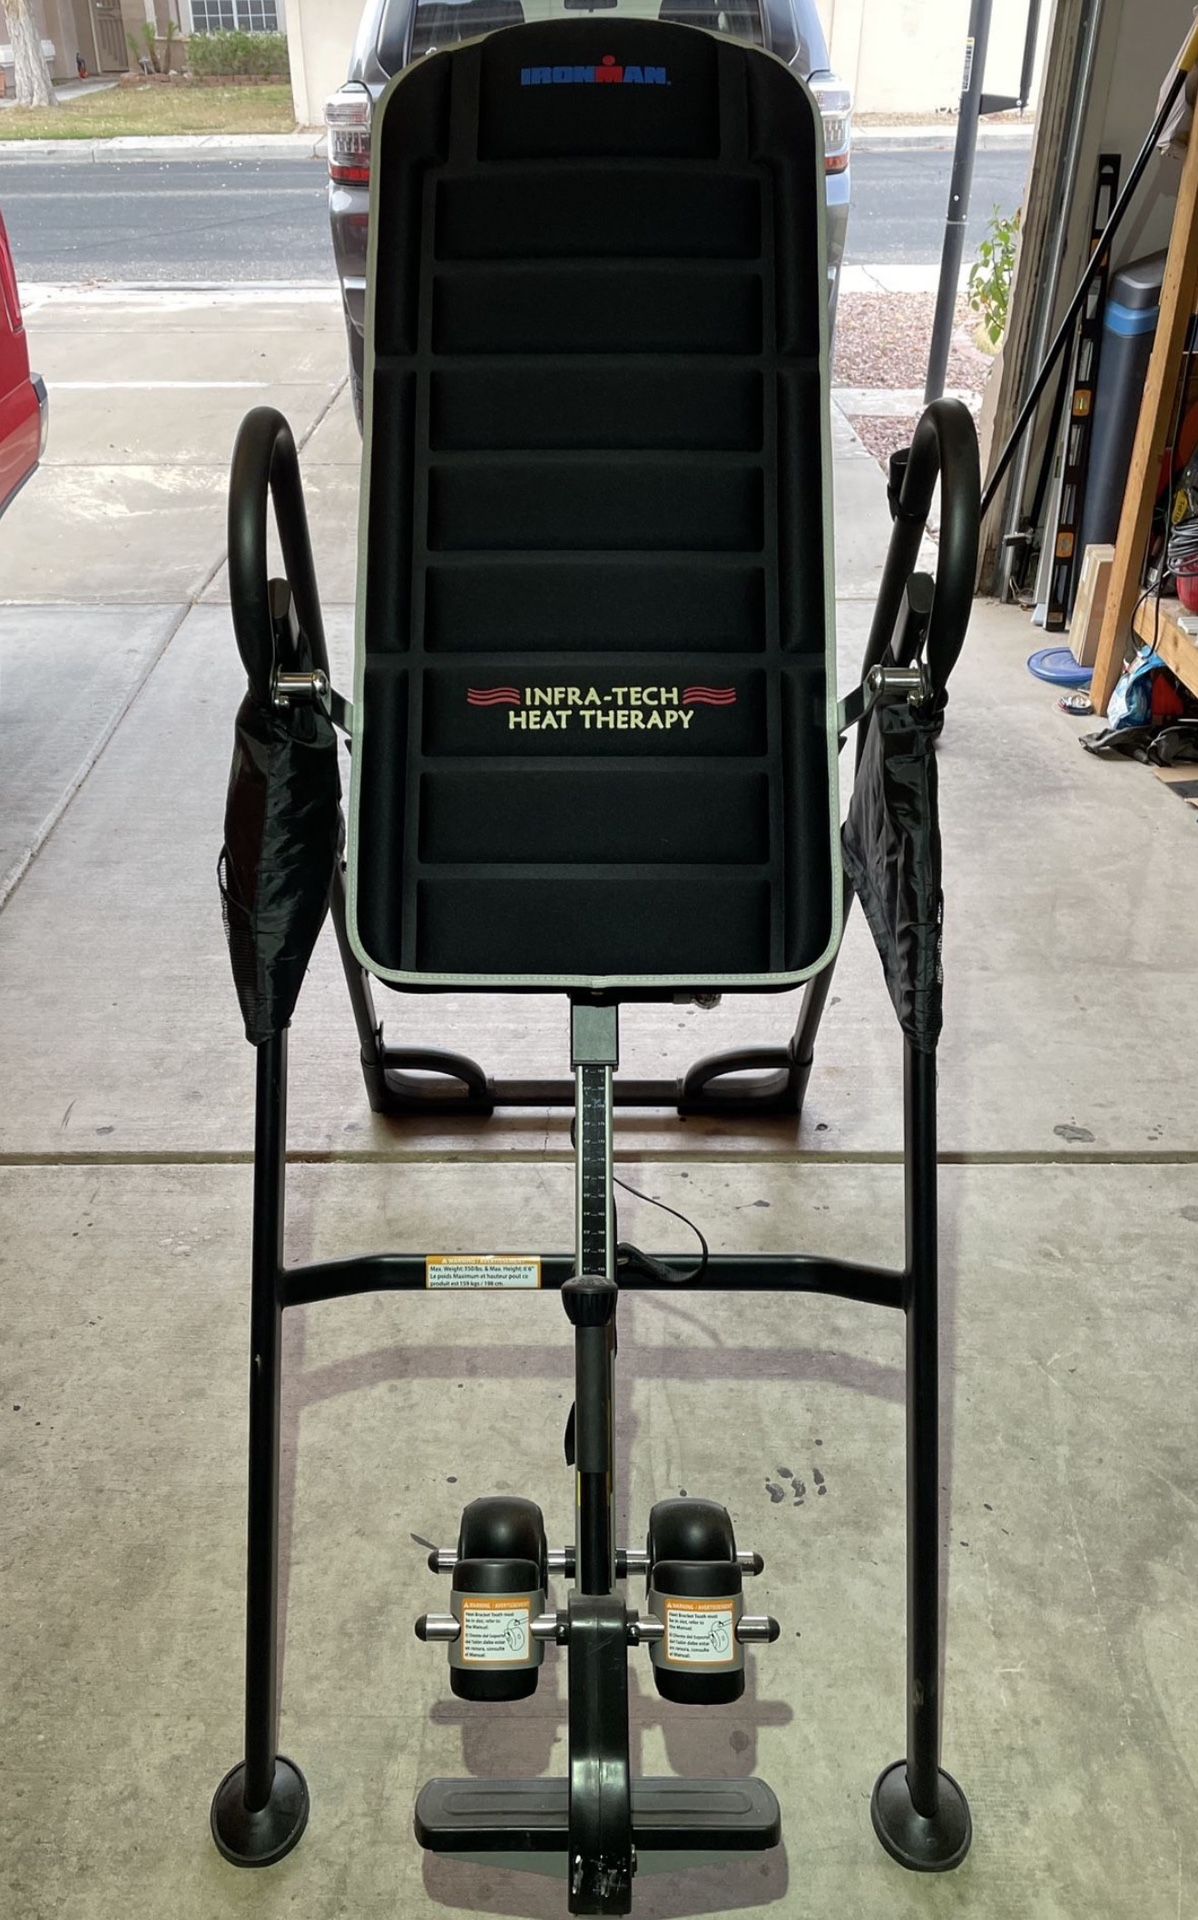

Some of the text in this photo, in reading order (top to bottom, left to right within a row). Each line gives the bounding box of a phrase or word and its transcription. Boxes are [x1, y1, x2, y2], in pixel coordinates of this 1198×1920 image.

[520, 55, 667, 86] IRONMAN
[524, 686, 679, 706] INFRA-TECH
[507, 709, 694, 730] HEAT THERAPY
